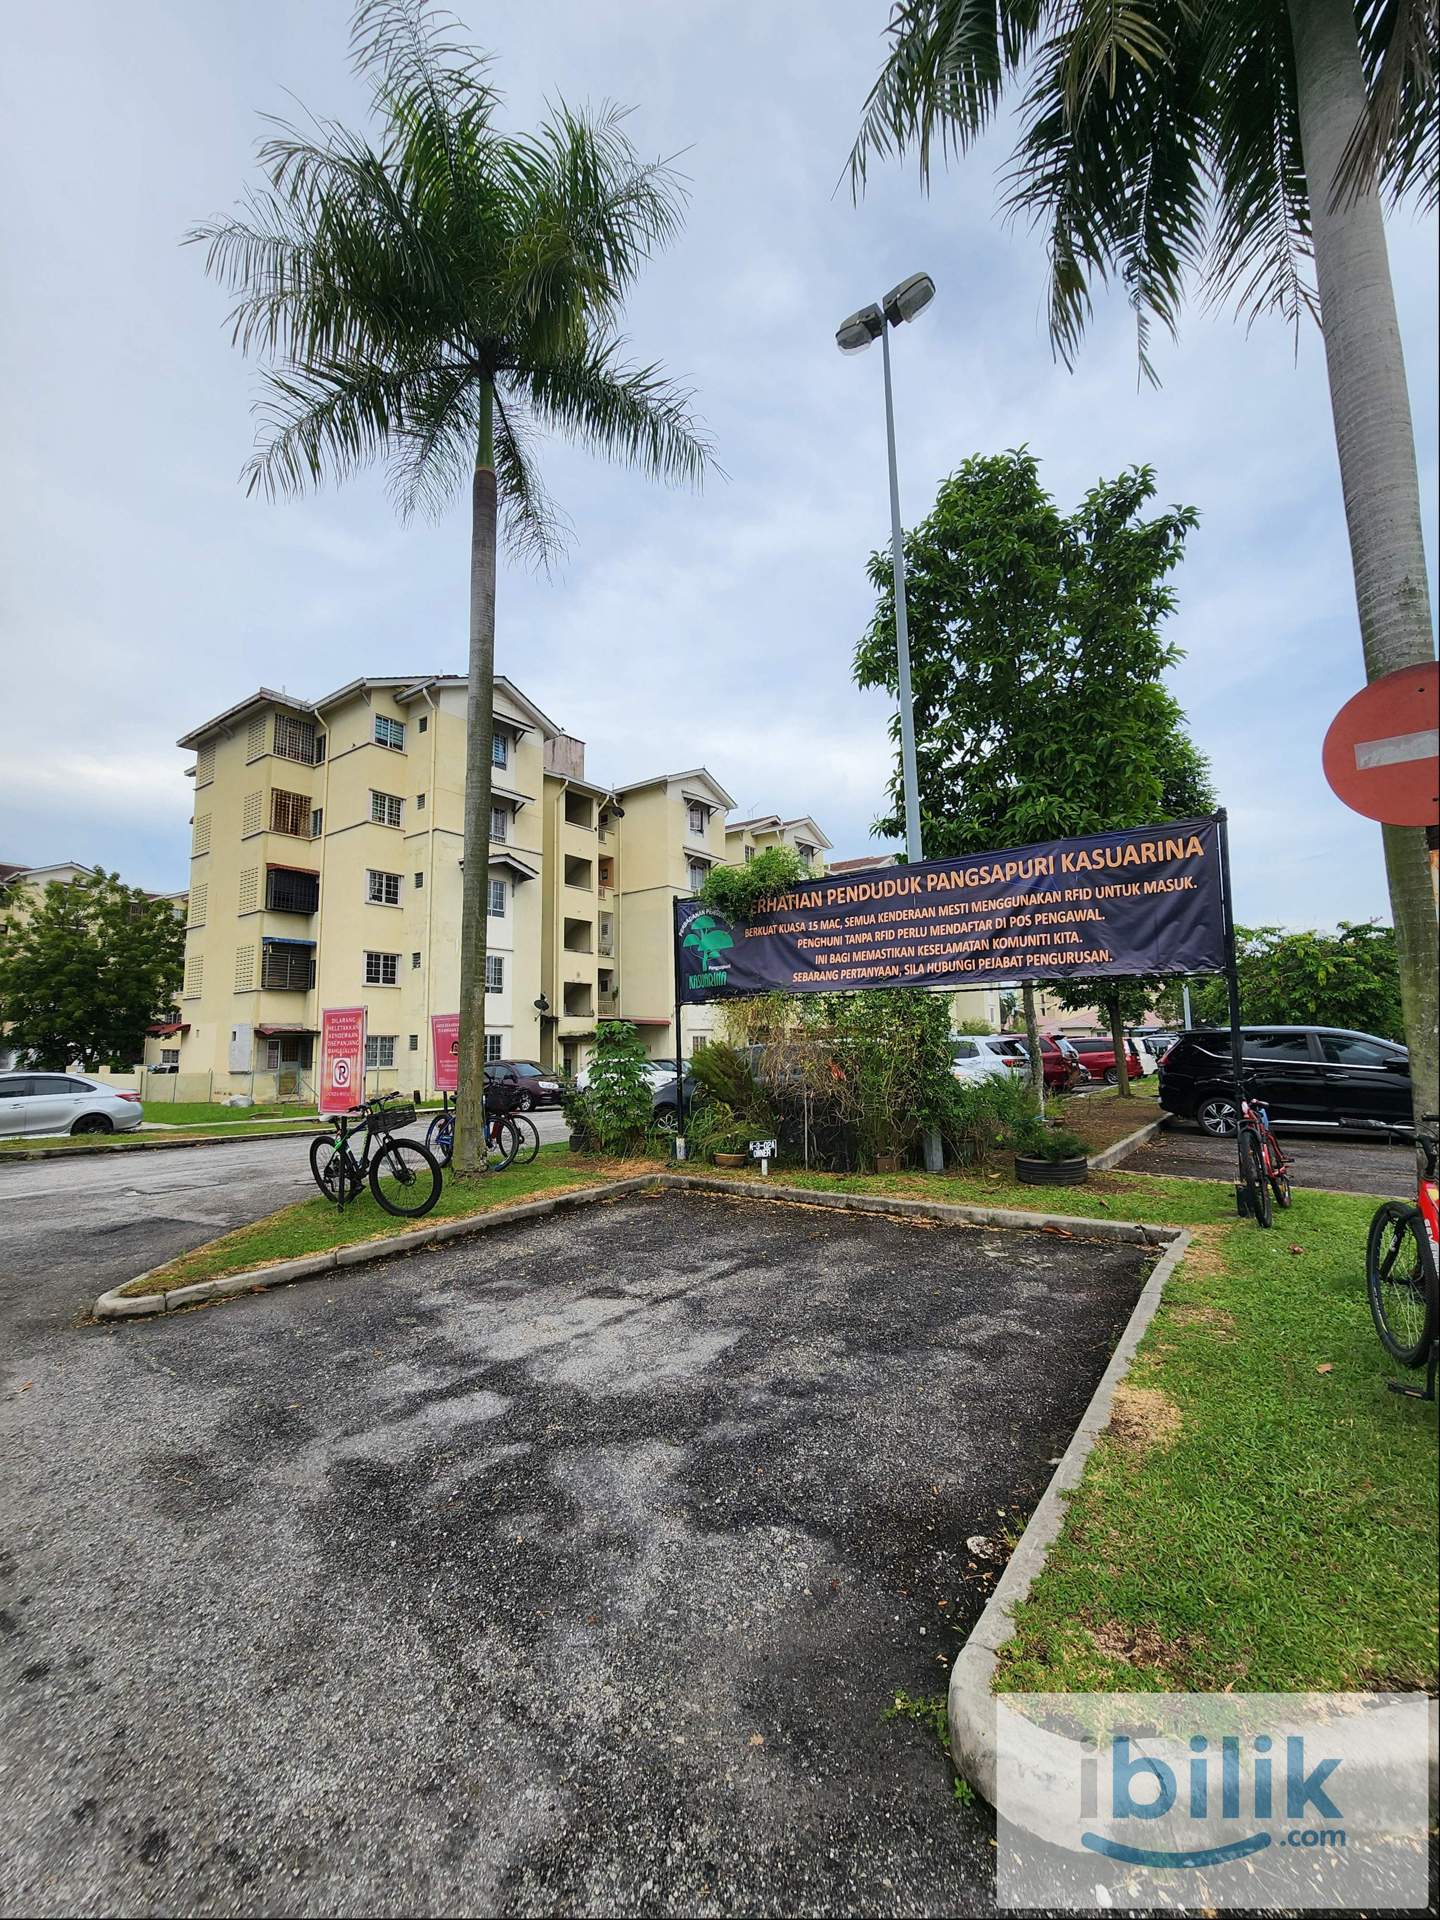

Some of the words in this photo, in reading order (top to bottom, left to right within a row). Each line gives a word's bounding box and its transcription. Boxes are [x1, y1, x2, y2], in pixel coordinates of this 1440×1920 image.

[750, 890, 822, 915] ERHATIAN
[827, 876, 922, 905] PENDUDUK
[927, 856, 1054, 891] PANGSAPURI
[1062, 836, 1204, 872] KASUARINA
[744, 924, 777, 938] BERKUAT
[778, 922, 806, 934] KUASA
[808, 921, 818, 931] 15
[820, 918, 843, 930] MAC,
[845, 916, 875, 928] SEMUA
[878, 907, 936, 923] KENDERAAN
[938, 903, 969, 917] MESTI
[971, 891, 1061, 911] MENGGUNAKAN
[1065, 887, 1092, 901] RFID
[1095, 883, 1140, 899] UNTUK
[1143, 876, 1197, 894] MASUK.
[797, 935, 843, 949] PENGHUNI
[845, 932, 872, 945] TANPA
[874, 929, 895, 942] RFID
[897, 925, 927, 939] PERLU
[930, 919, 992, 937] MENDAFTAR
[995, 917, 1007, 930] DI
[1010, 914, 1031, 928] POS
[1034, 909, 1105, 926] PENGAWAL.
[792, 970, 838, 983] SEBARANG
[840, 965, 902, 980] PERTANYAAN,
[904, 962, 925, 976] SILA
[927, 959, 975, 974] HUBUNGI
[978, 955, 1023, 970] PEJABAT
[1026, 949, 1113, 967] PENGURUSAN.
[815, 953, 828, 965] INI
[829, 952, 850, 964] BAGI
[852, 946, 915, 962] MEMASTIKAN
[917, 939, 989, 957] KESELAMATAN
[992, 933, 1050, 950] KOMUNITI
[1053, 931, 1083, 945] KITA.
[689, 971, 727, 989] KASUARINA
